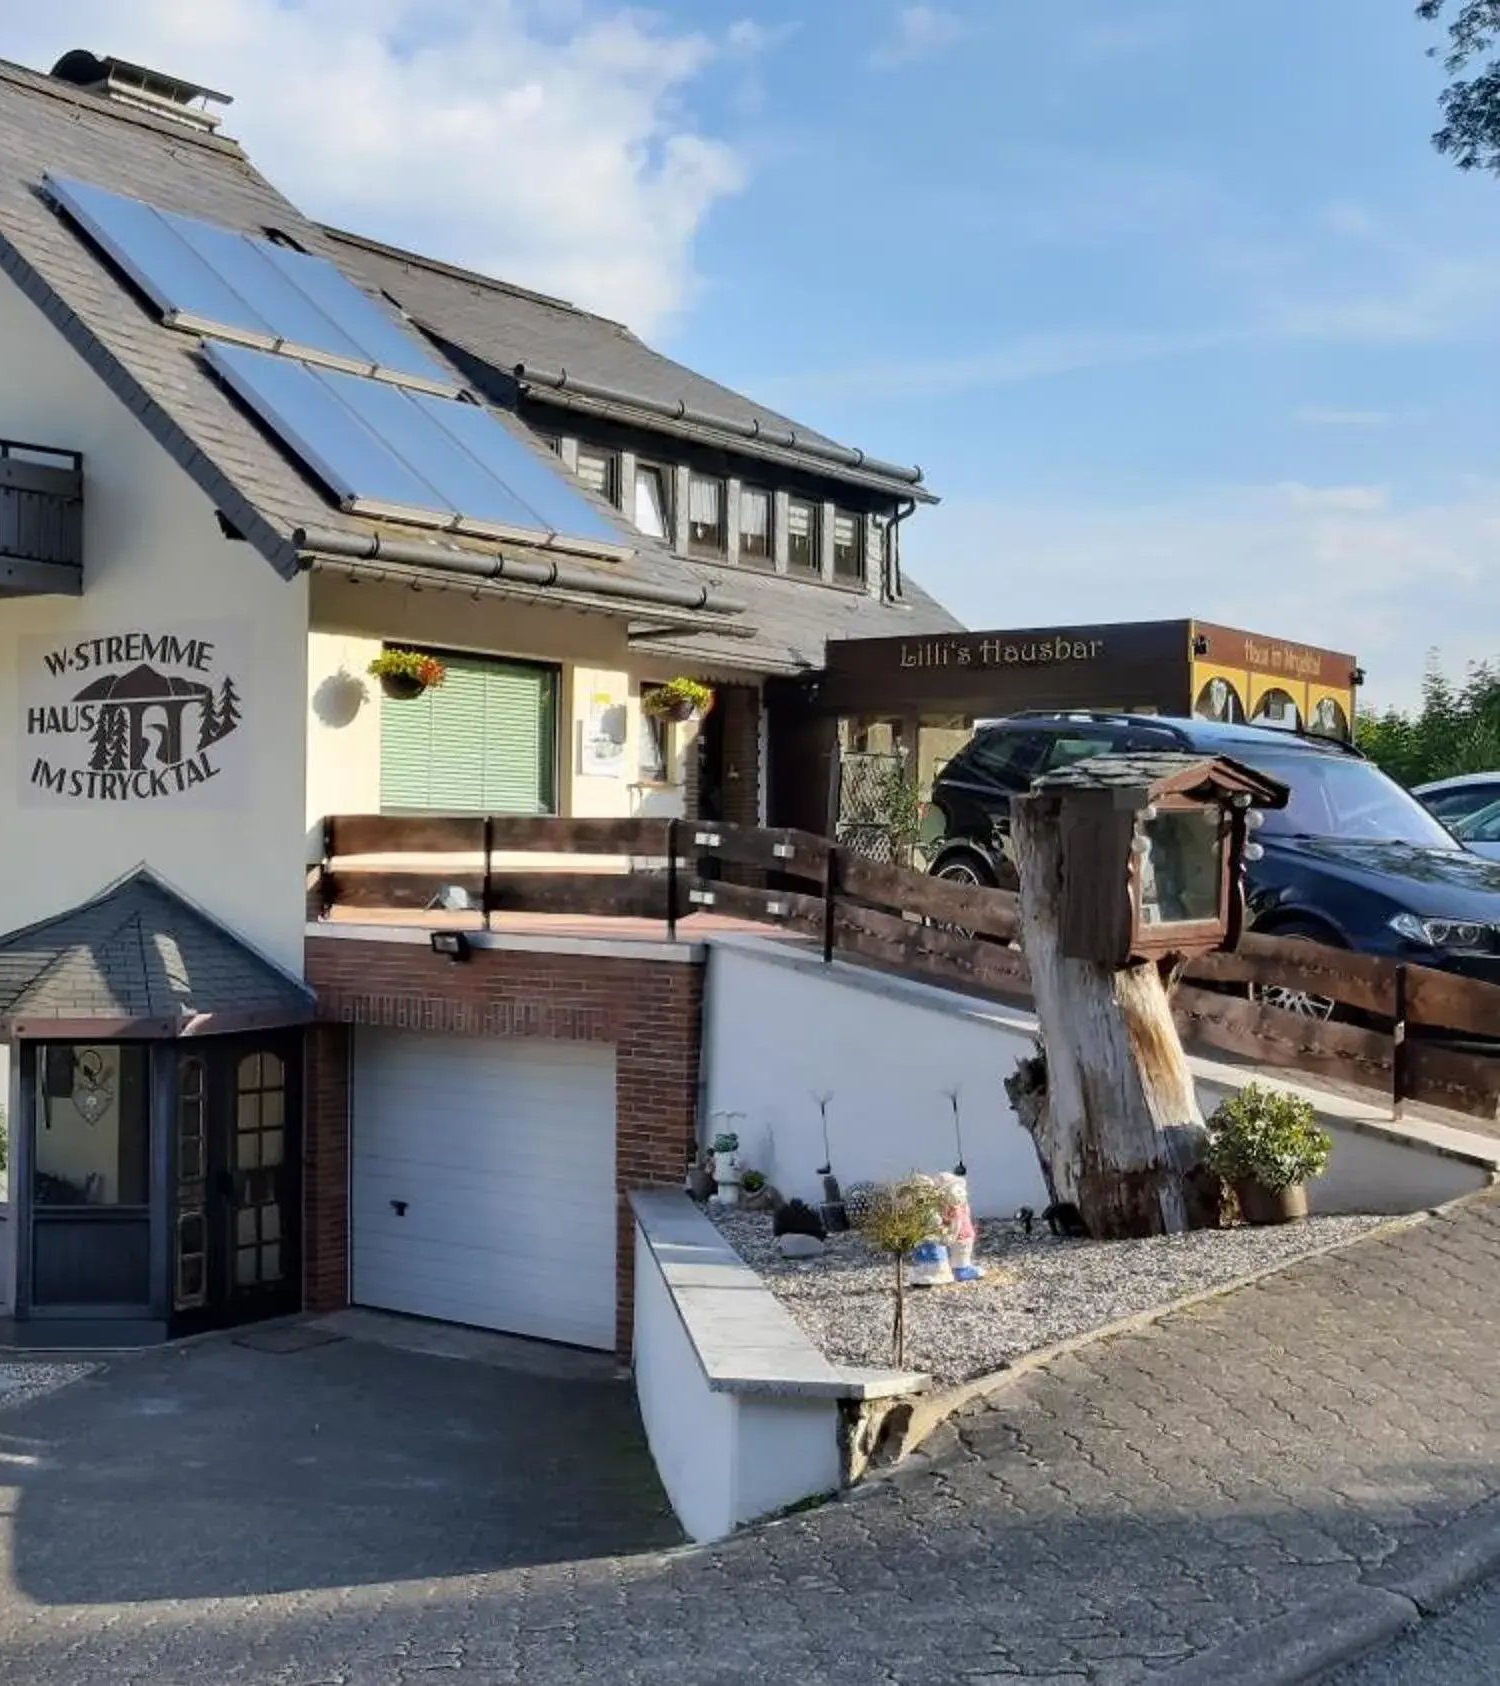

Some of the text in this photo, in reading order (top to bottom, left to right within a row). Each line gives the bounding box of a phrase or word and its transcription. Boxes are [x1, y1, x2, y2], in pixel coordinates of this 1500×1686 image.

[979, 635, 1104, 663] Hausbar
[27, 704, 95, 735] HAUS
[68, 752, 221, 801] STRYCKTAL
